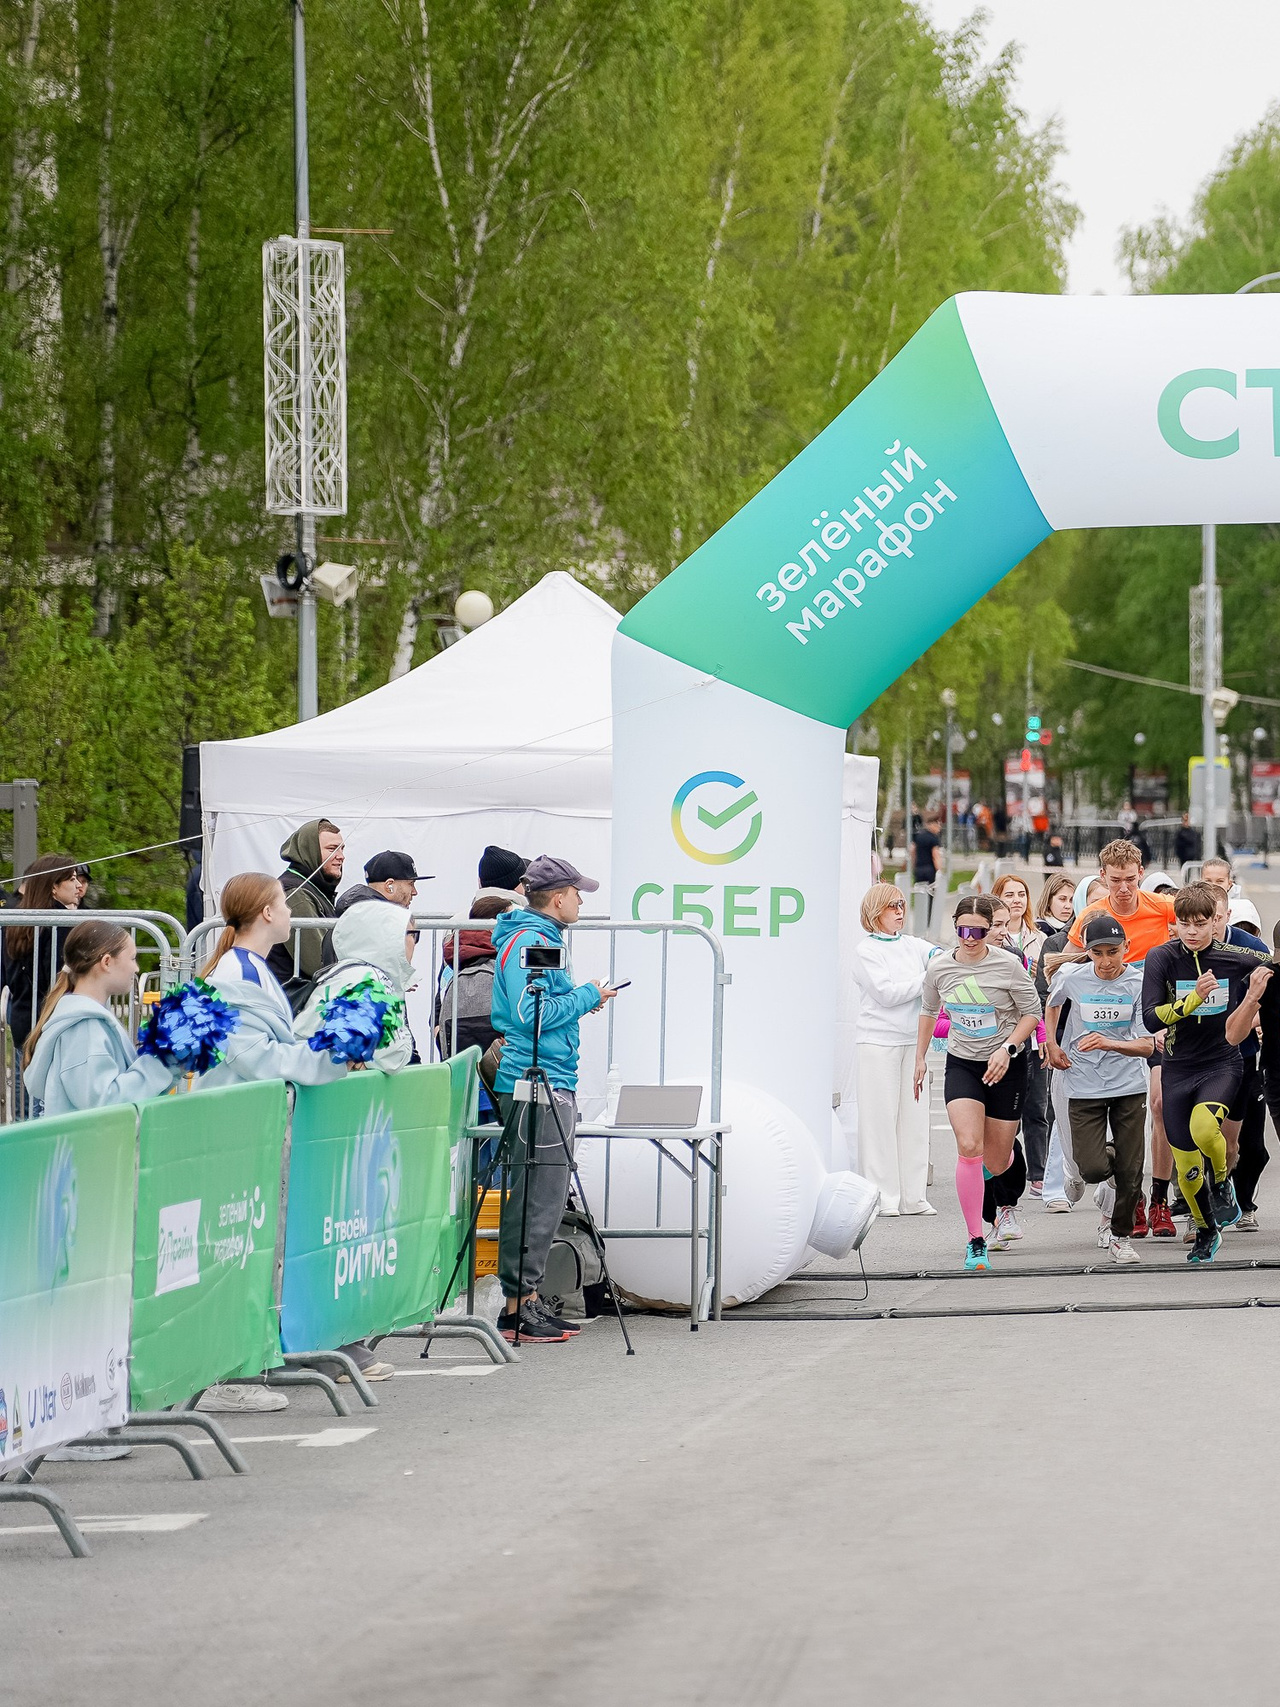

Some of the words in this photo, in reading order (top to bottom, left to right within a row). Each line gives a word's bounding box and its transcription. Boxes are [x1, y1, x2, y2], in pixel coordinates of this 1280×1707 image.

[756, 438, 928, 613] зелёный
[784, 478, 959, 646] марафон
[631, 882, 806, 938] СБЕР
[960, 1017, 983, 1028] 3311
[1093, 1010, 1120, 1020] 3319
[323, 1216, 333, 1246] В
[334, 1209, 368, 1243] твоём
[334, 1238, 398, 1300] ритме
